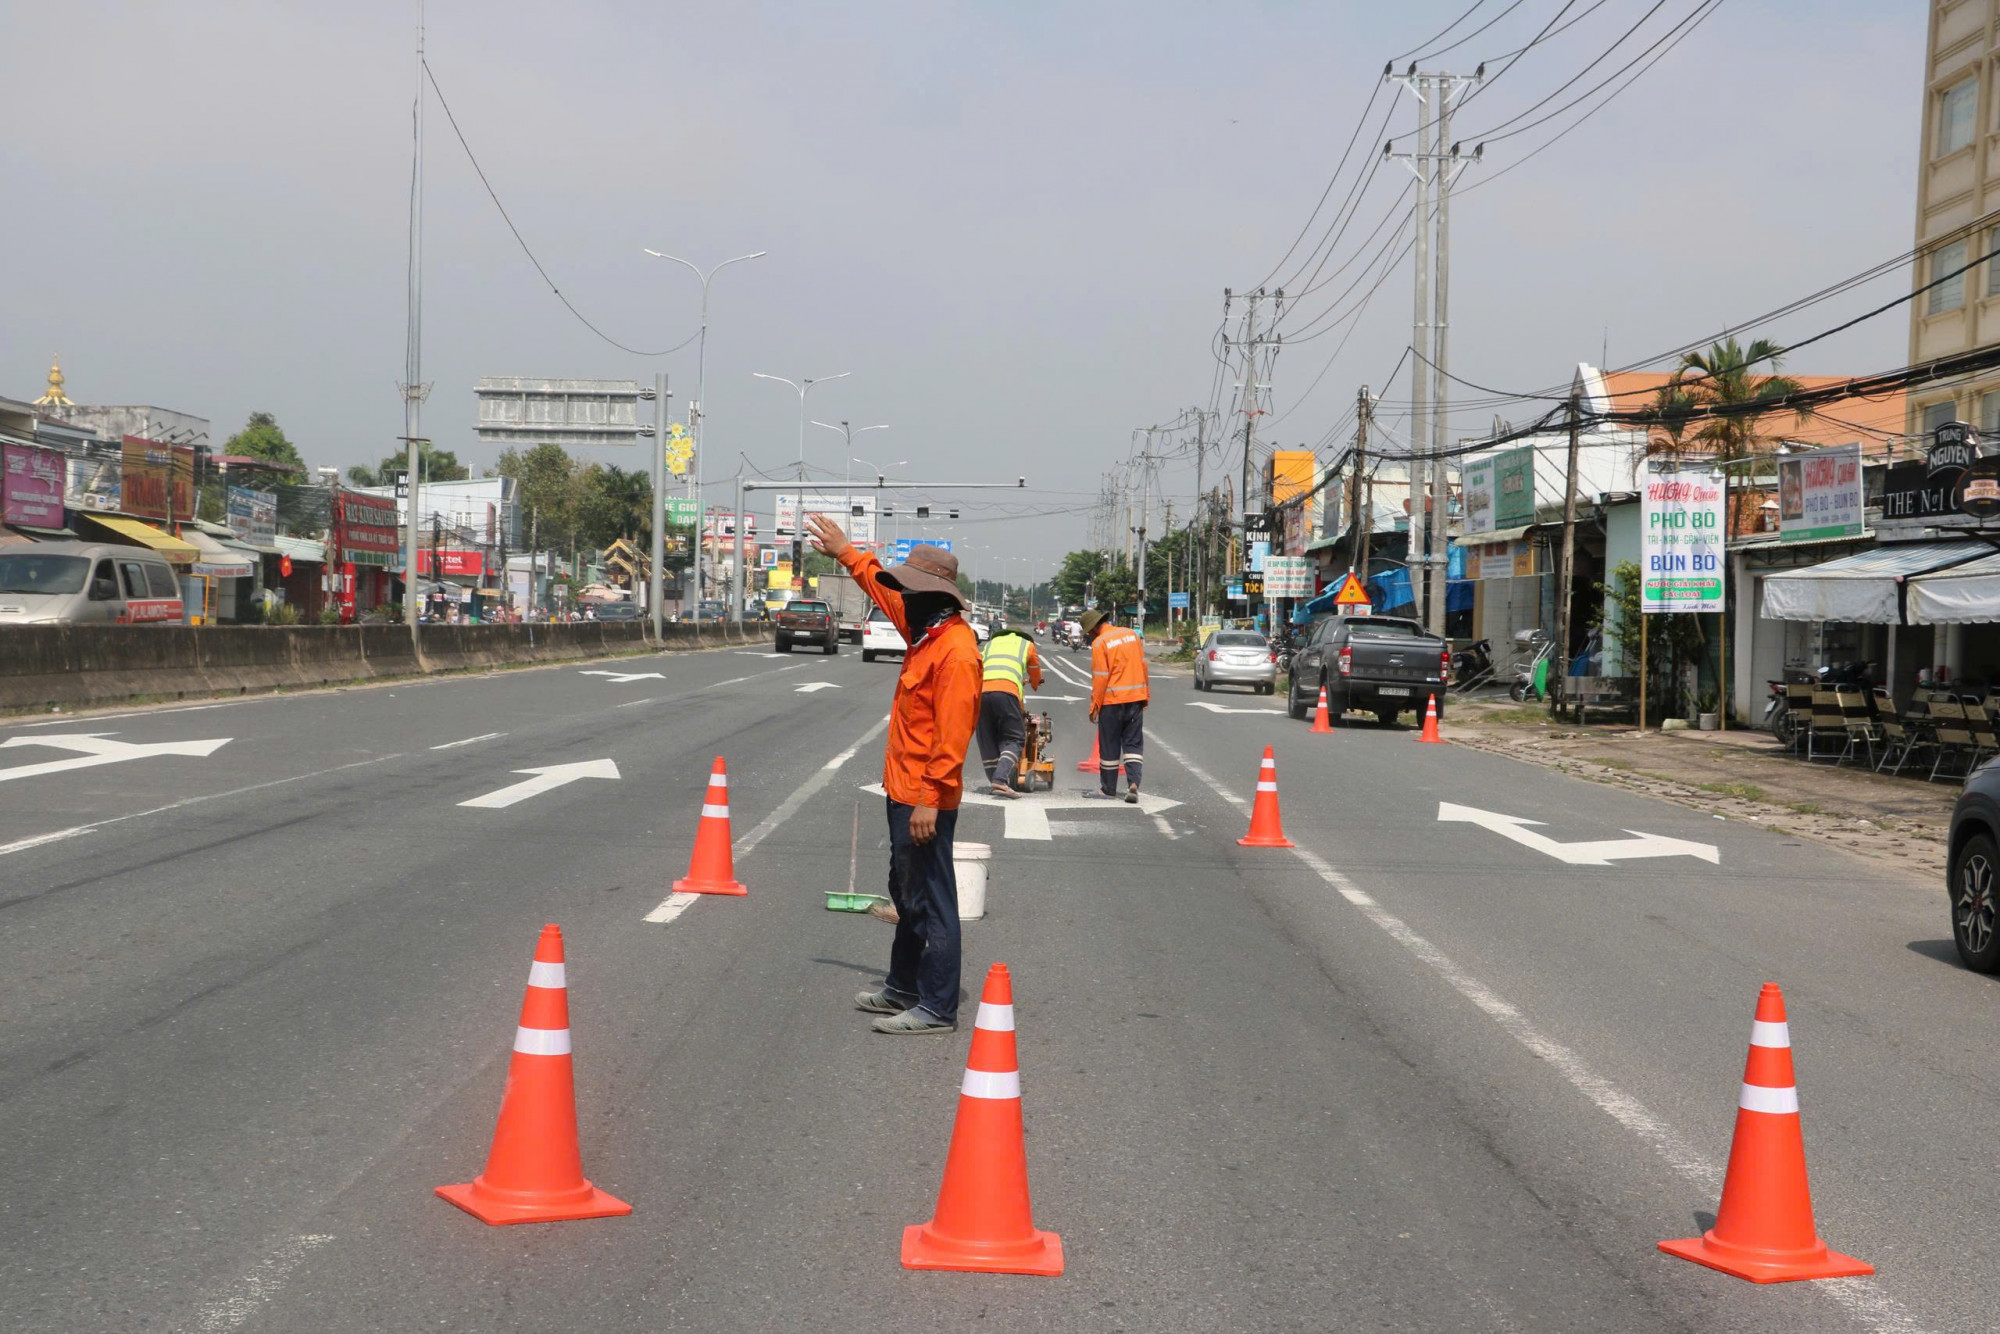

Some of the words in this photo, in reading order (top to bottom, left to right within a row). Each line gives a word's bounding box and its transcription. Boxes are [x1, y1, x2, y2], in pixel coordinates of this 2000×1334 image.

[1938, 428, 1962, 443] TRUNG
[1886, 490, 1914, 515] THE
[1650, 507, 1686, 529] PHỞ
[1692, 508, 1716, 529] BÒ
[1246, 529, 1271, 542] KÍNH
[1651, 552, 1686, 571] BÚN
[1692, 551, 1716, 571] BÒ
